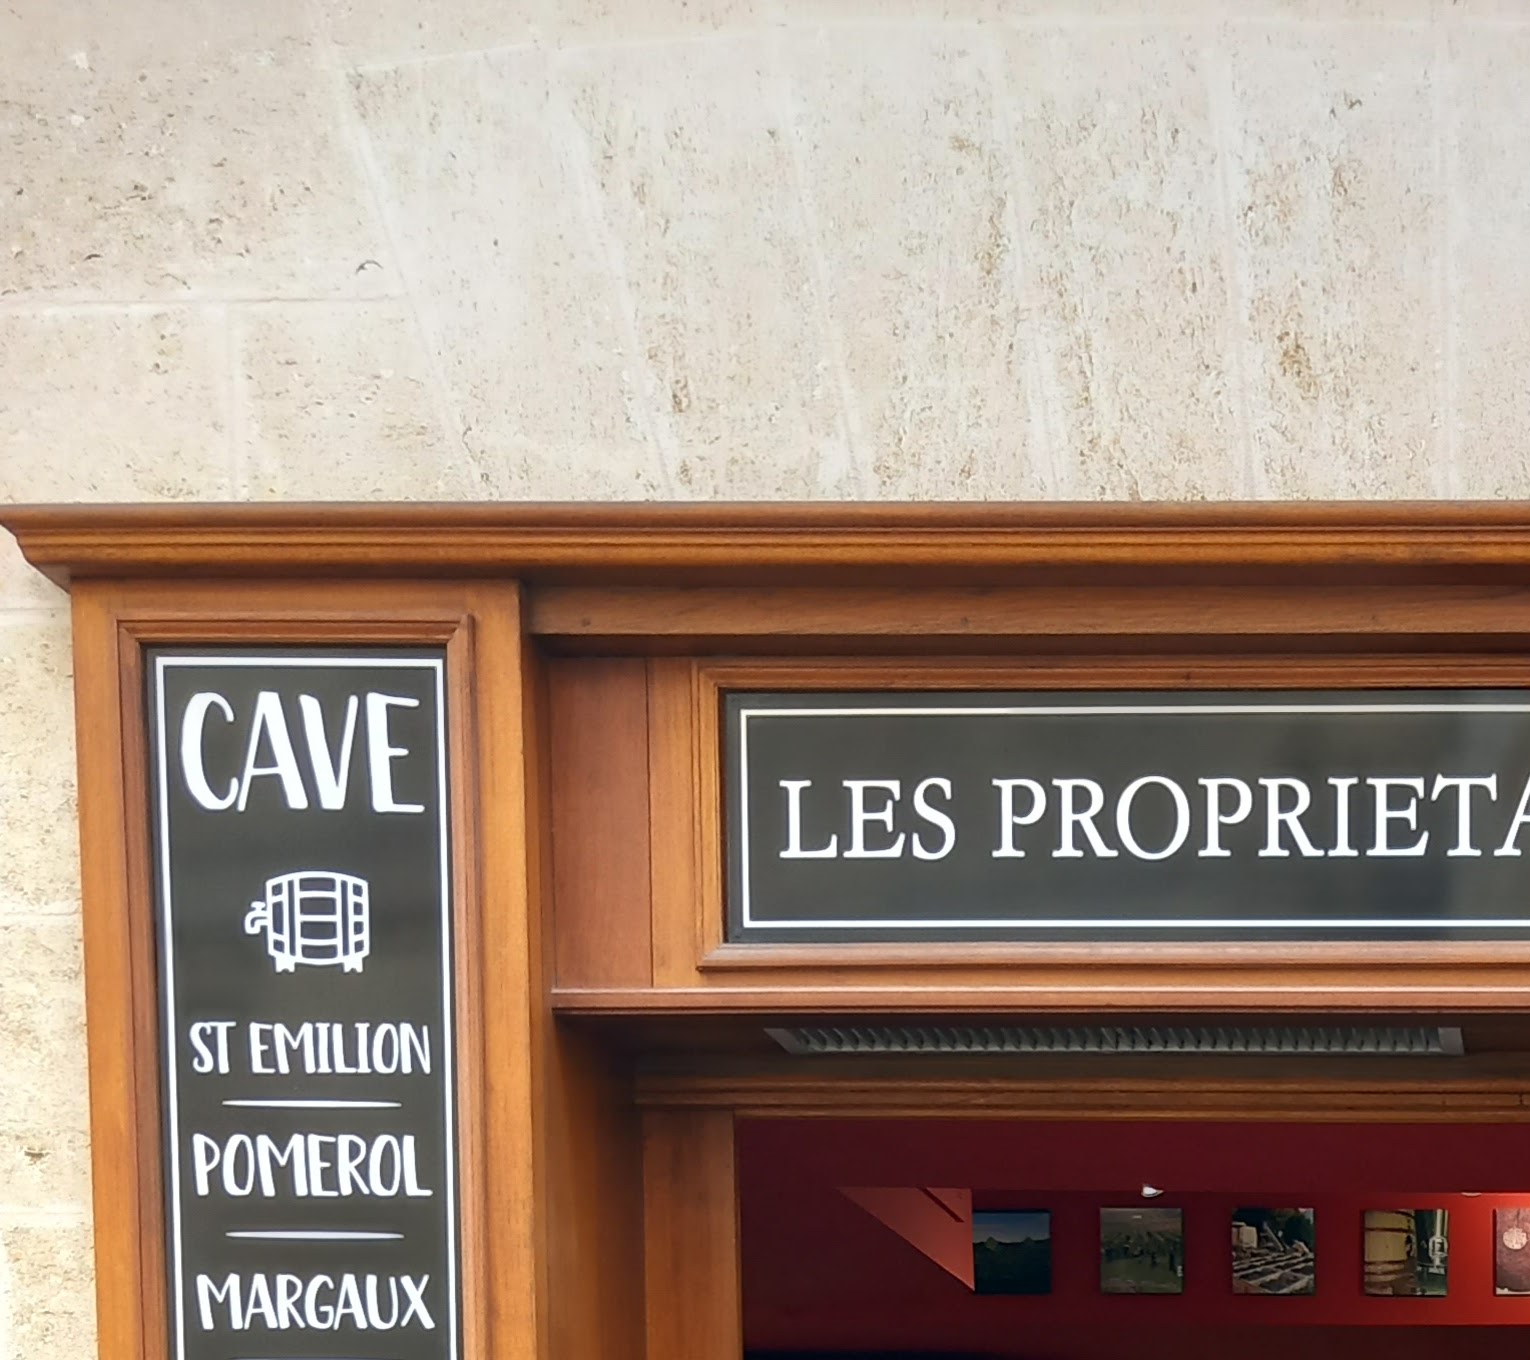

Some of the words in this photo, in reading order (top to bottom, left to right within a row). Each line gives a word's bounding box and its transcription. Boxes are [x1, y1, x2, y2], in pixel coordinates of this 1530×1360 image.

[181, 691, 425, 812] CAVE
[780, 778, 955, 860] LES
[190, 1022, 236, 1073] ST
[250, 1022, 430, 1074] EMILION
[193, 1133, 433, 1197] POMEROL
[197, 1273, 435, 1330] MARGAUX
